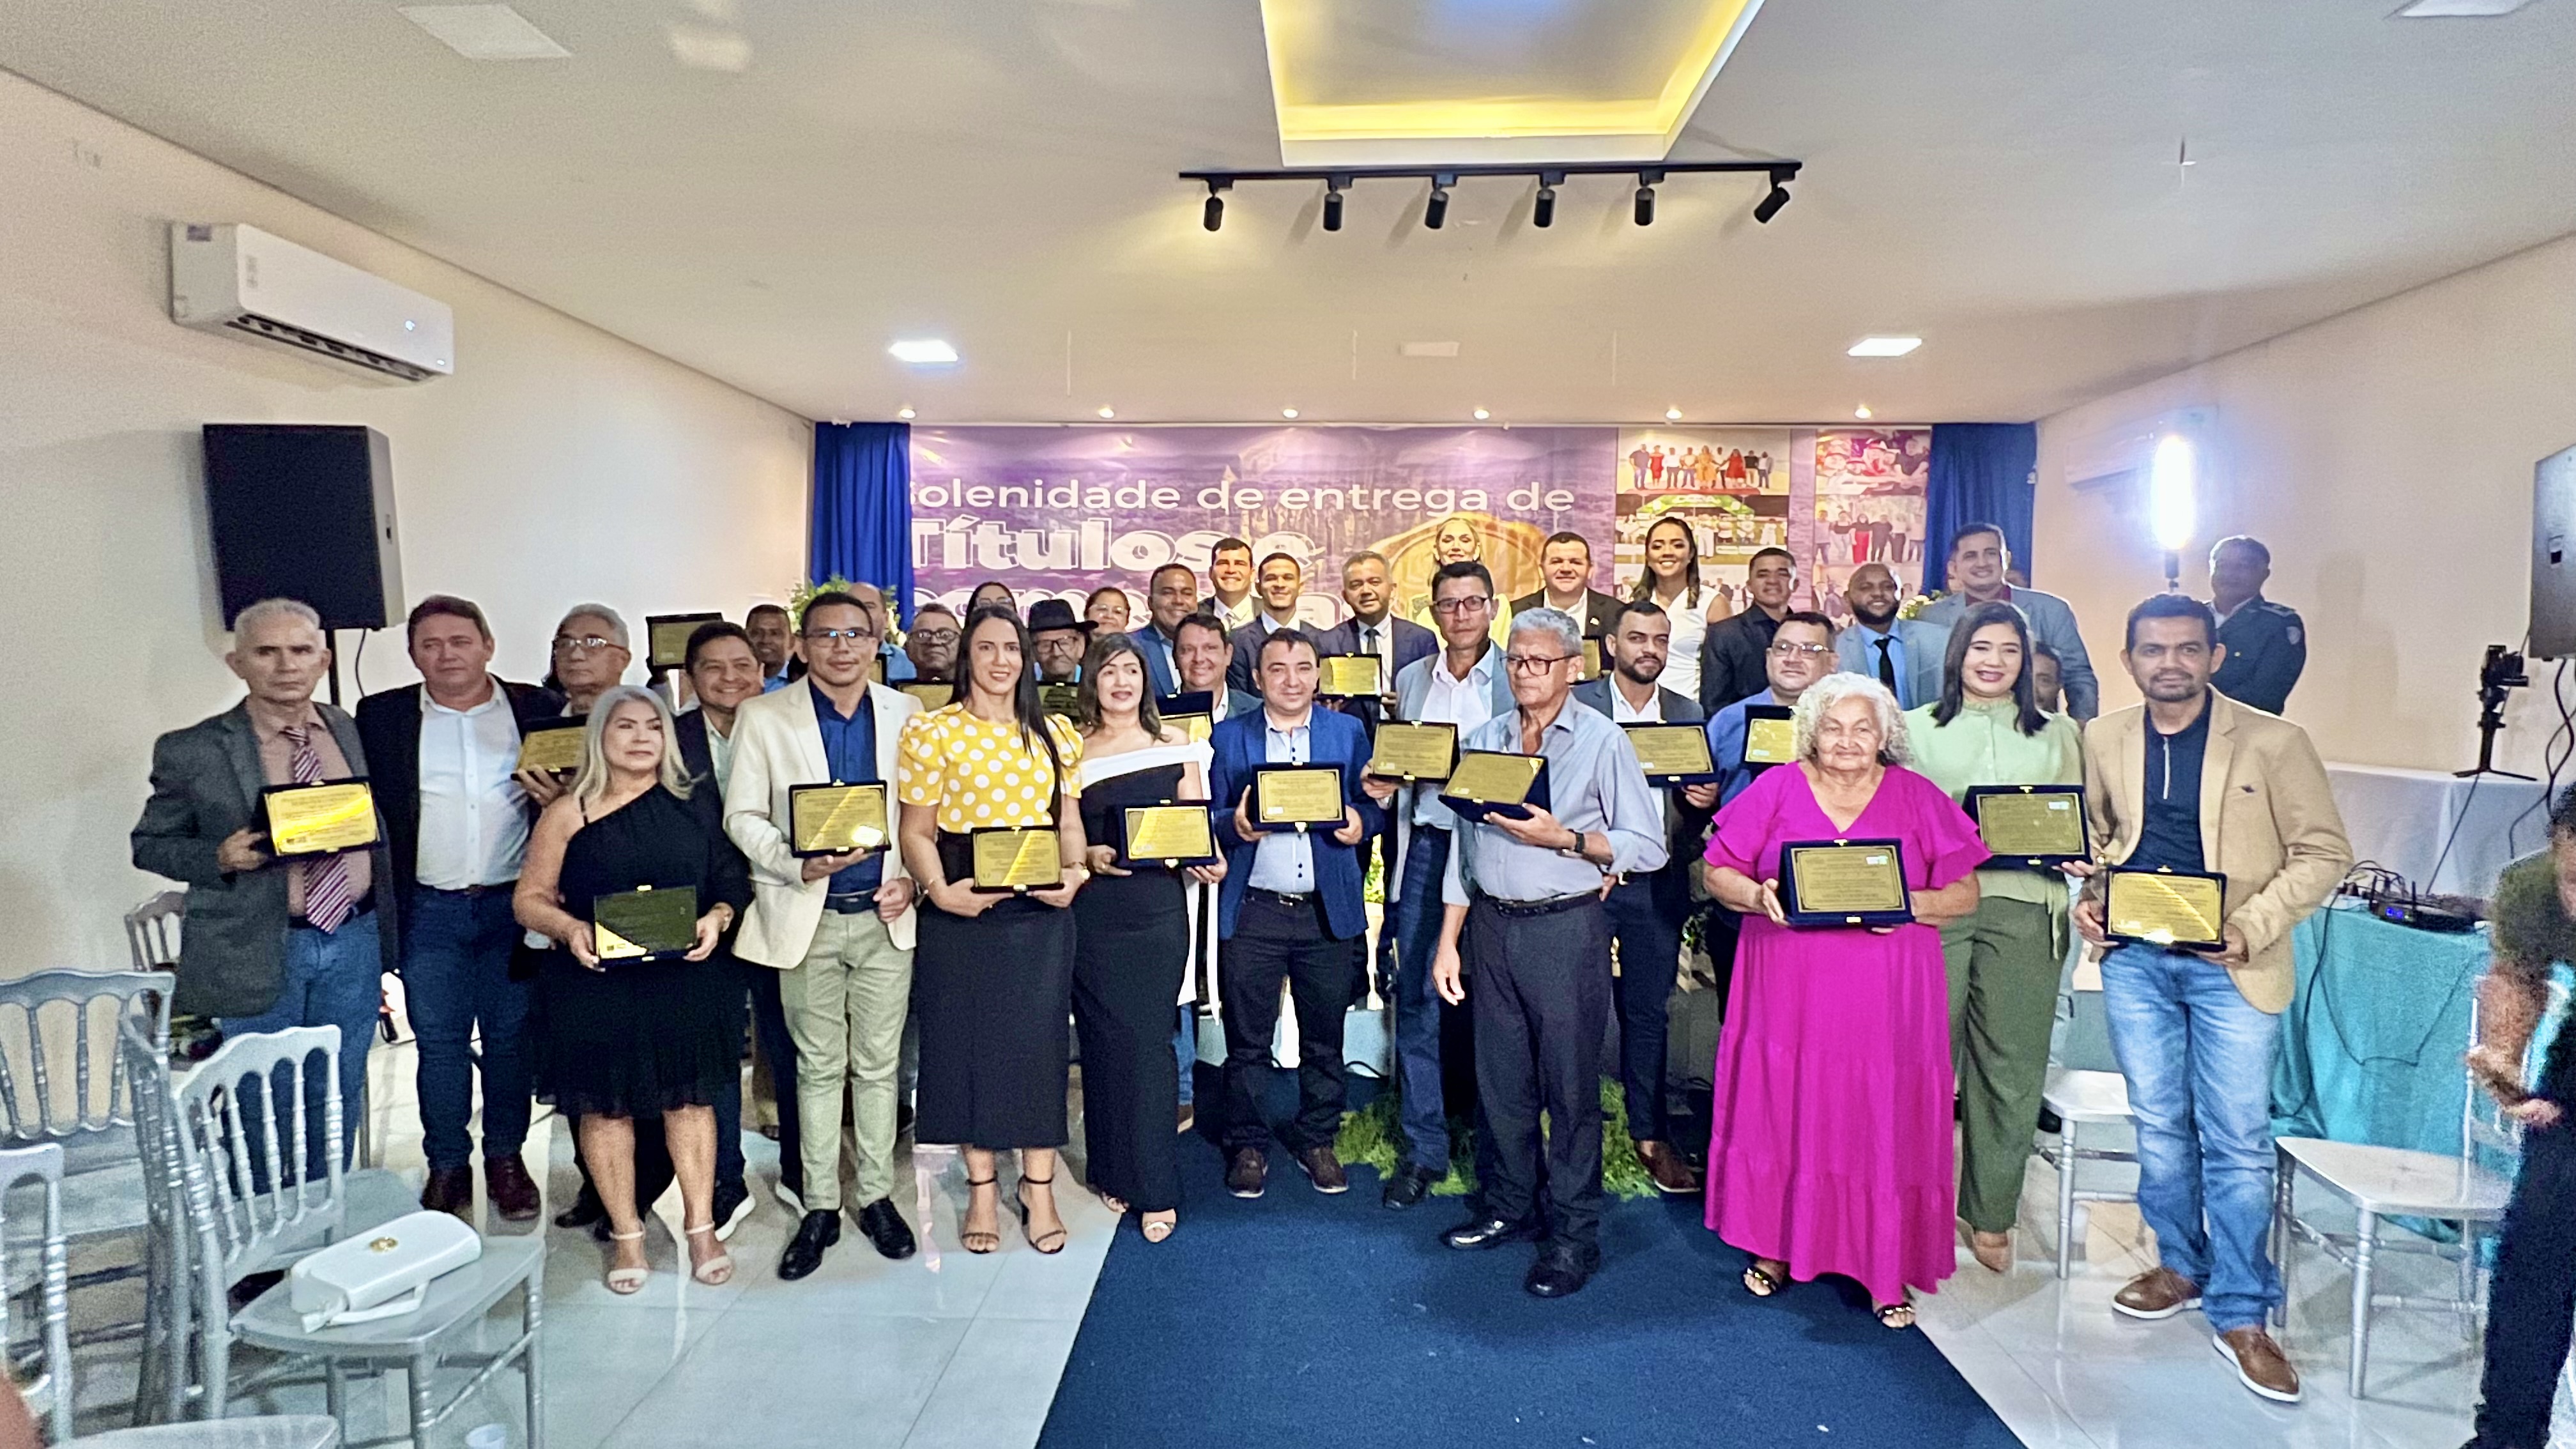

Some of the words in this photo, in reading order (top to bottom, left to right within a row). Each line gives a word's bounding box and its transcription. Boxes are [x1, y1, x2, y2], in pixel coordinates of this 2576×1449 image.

[910, 479, 1181, 509] olenidade
[1197, 479, 1264, 510] de
[1279, 483, 1488, 517] entrega
[1506, 481, 1575, 512] de
